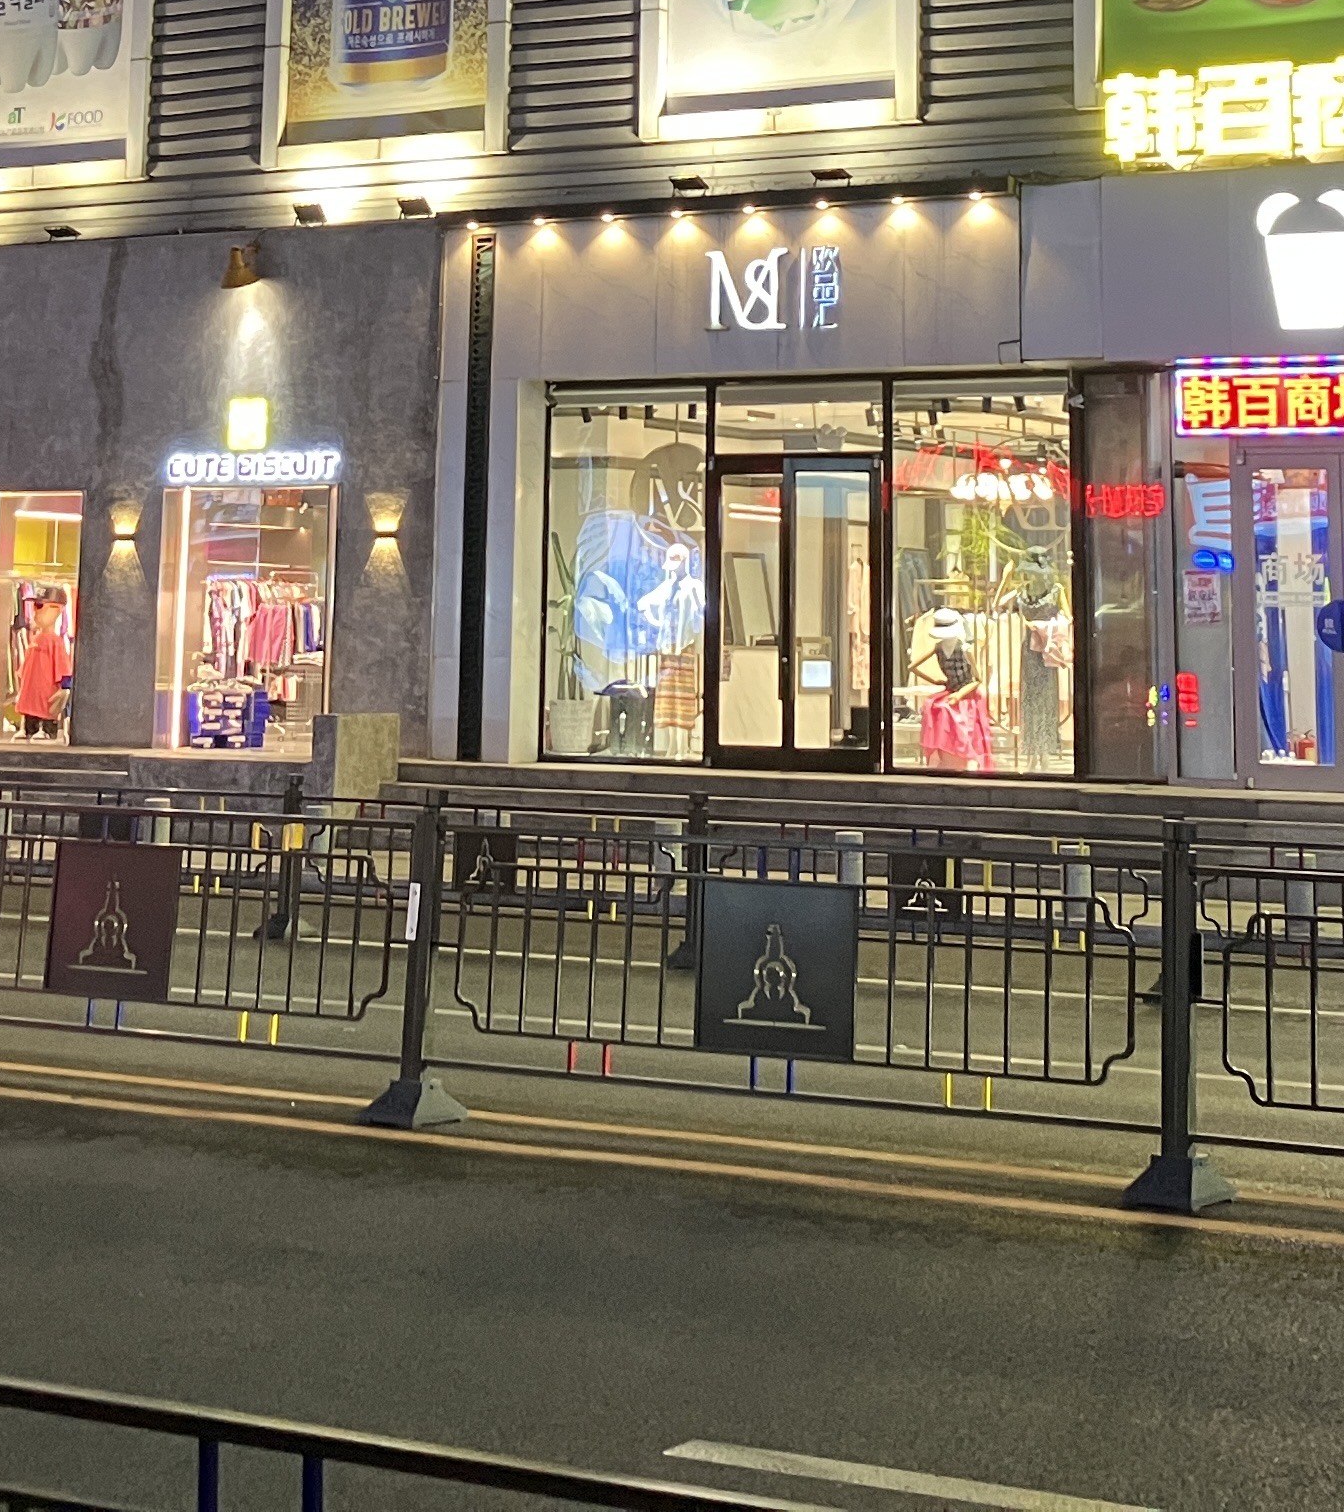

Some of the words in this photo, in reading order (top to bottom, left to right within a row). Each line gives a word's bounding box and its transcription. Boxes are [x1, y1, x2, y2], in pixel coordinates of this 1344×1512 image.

[340, 6, 373, 35] OLD
[67, 109, 104, 126] FOOD
[168, 454, 233, 481] CUTE
[1258, 552, 1325, 586] 商场
